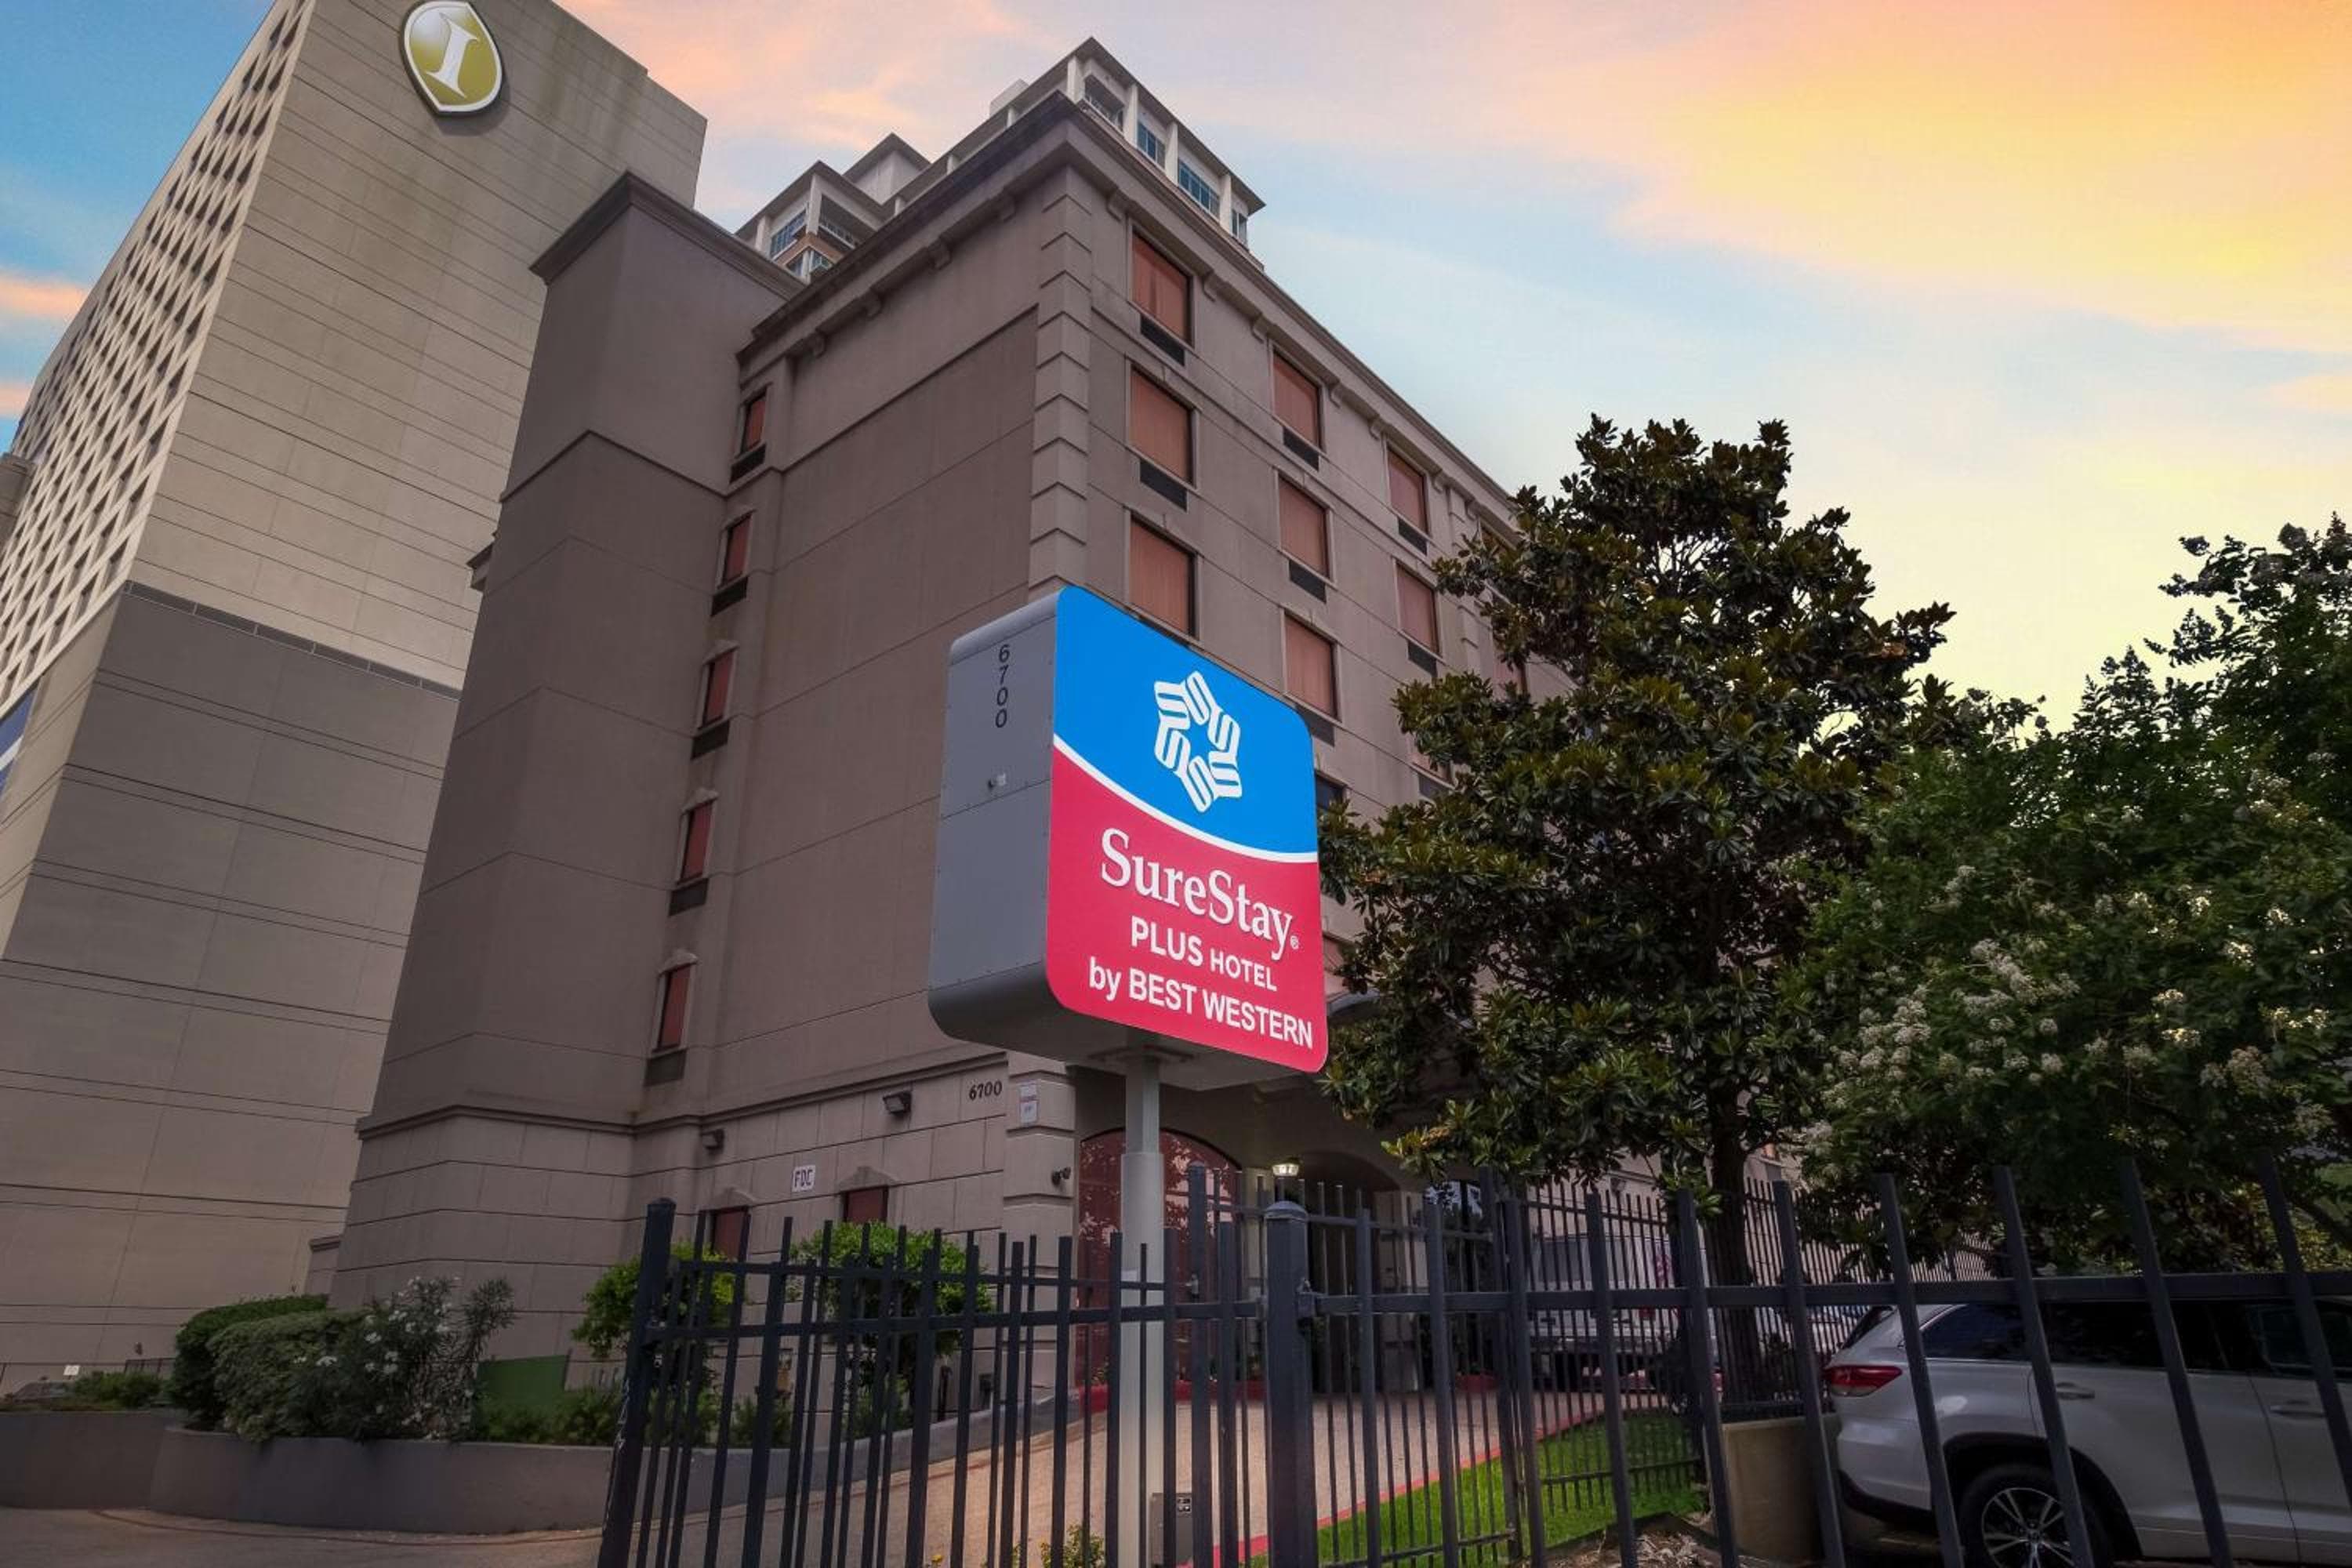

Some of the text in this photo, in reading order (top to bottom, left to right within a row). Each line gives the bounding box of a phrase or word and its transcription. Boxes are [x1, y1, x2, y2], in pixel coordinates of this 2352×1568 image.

[995, 644, 1011, 728] 6700
[1131, 915, 1277, 992] PLUS HOTEL
[1088, 956, 1312, 1050] by BEST WESTERN
[969, 1080, 1003, 1101] 6700
[794, 1169, 813, 1187] FDC
